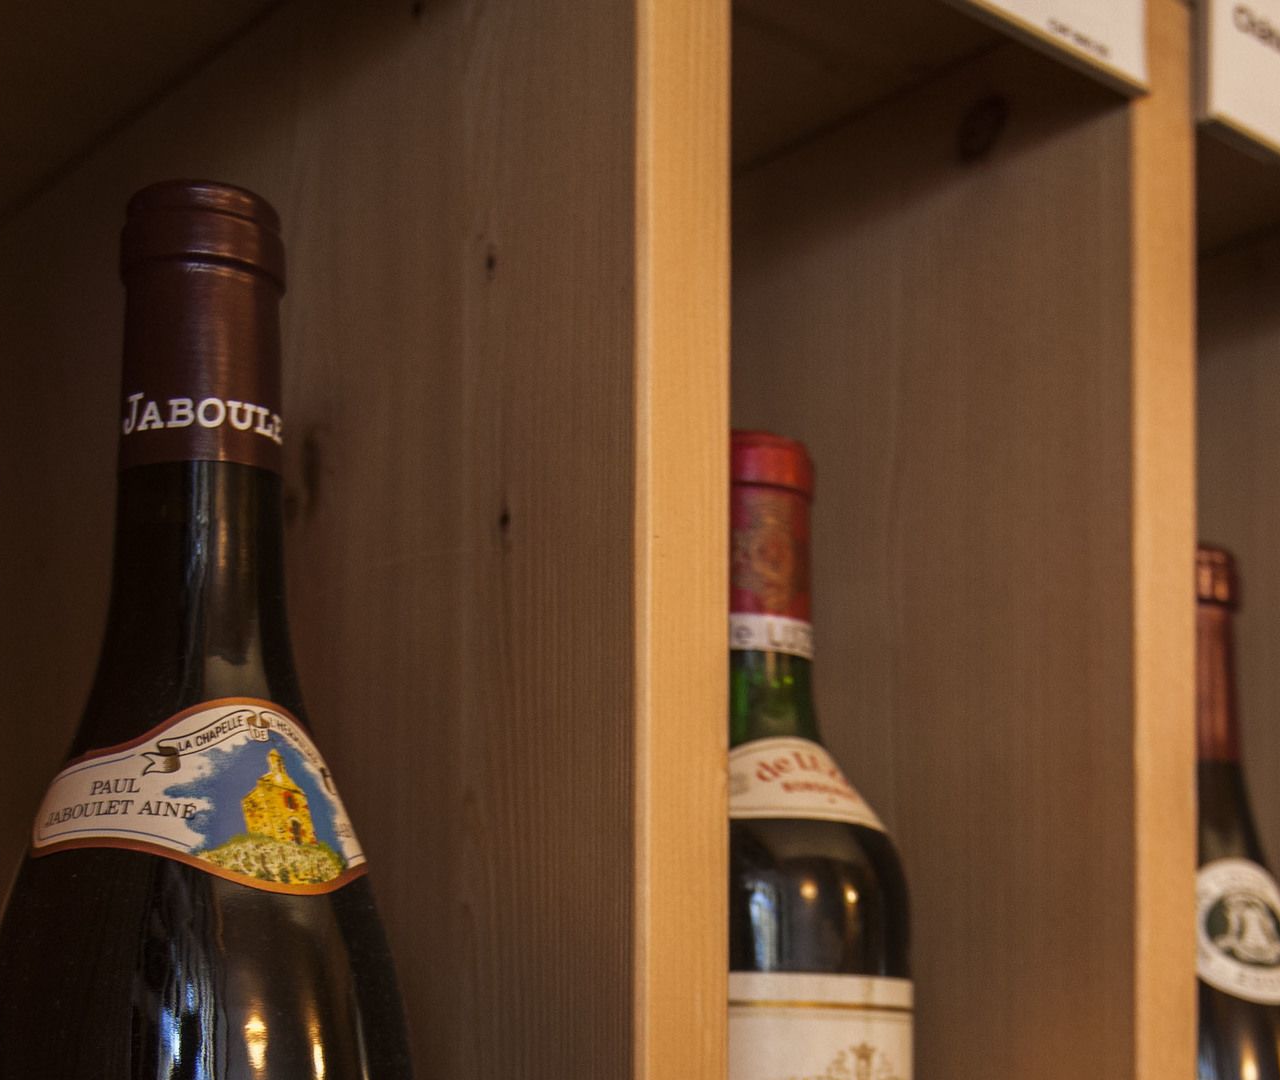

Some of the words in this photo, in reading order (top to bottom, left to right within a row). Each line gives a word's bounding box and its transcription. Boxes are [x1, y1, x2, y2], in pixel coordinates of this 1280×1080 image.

[178, 739, 193, 752] LA
[195, 715, 245, 747] CHAPELLE
[253, 728, 266, 740] DE
[89, 778, 140, 796] PAUL
[45, 799, 135, 829] JABOULET
[138, 799, 198, 821] AINÉ
